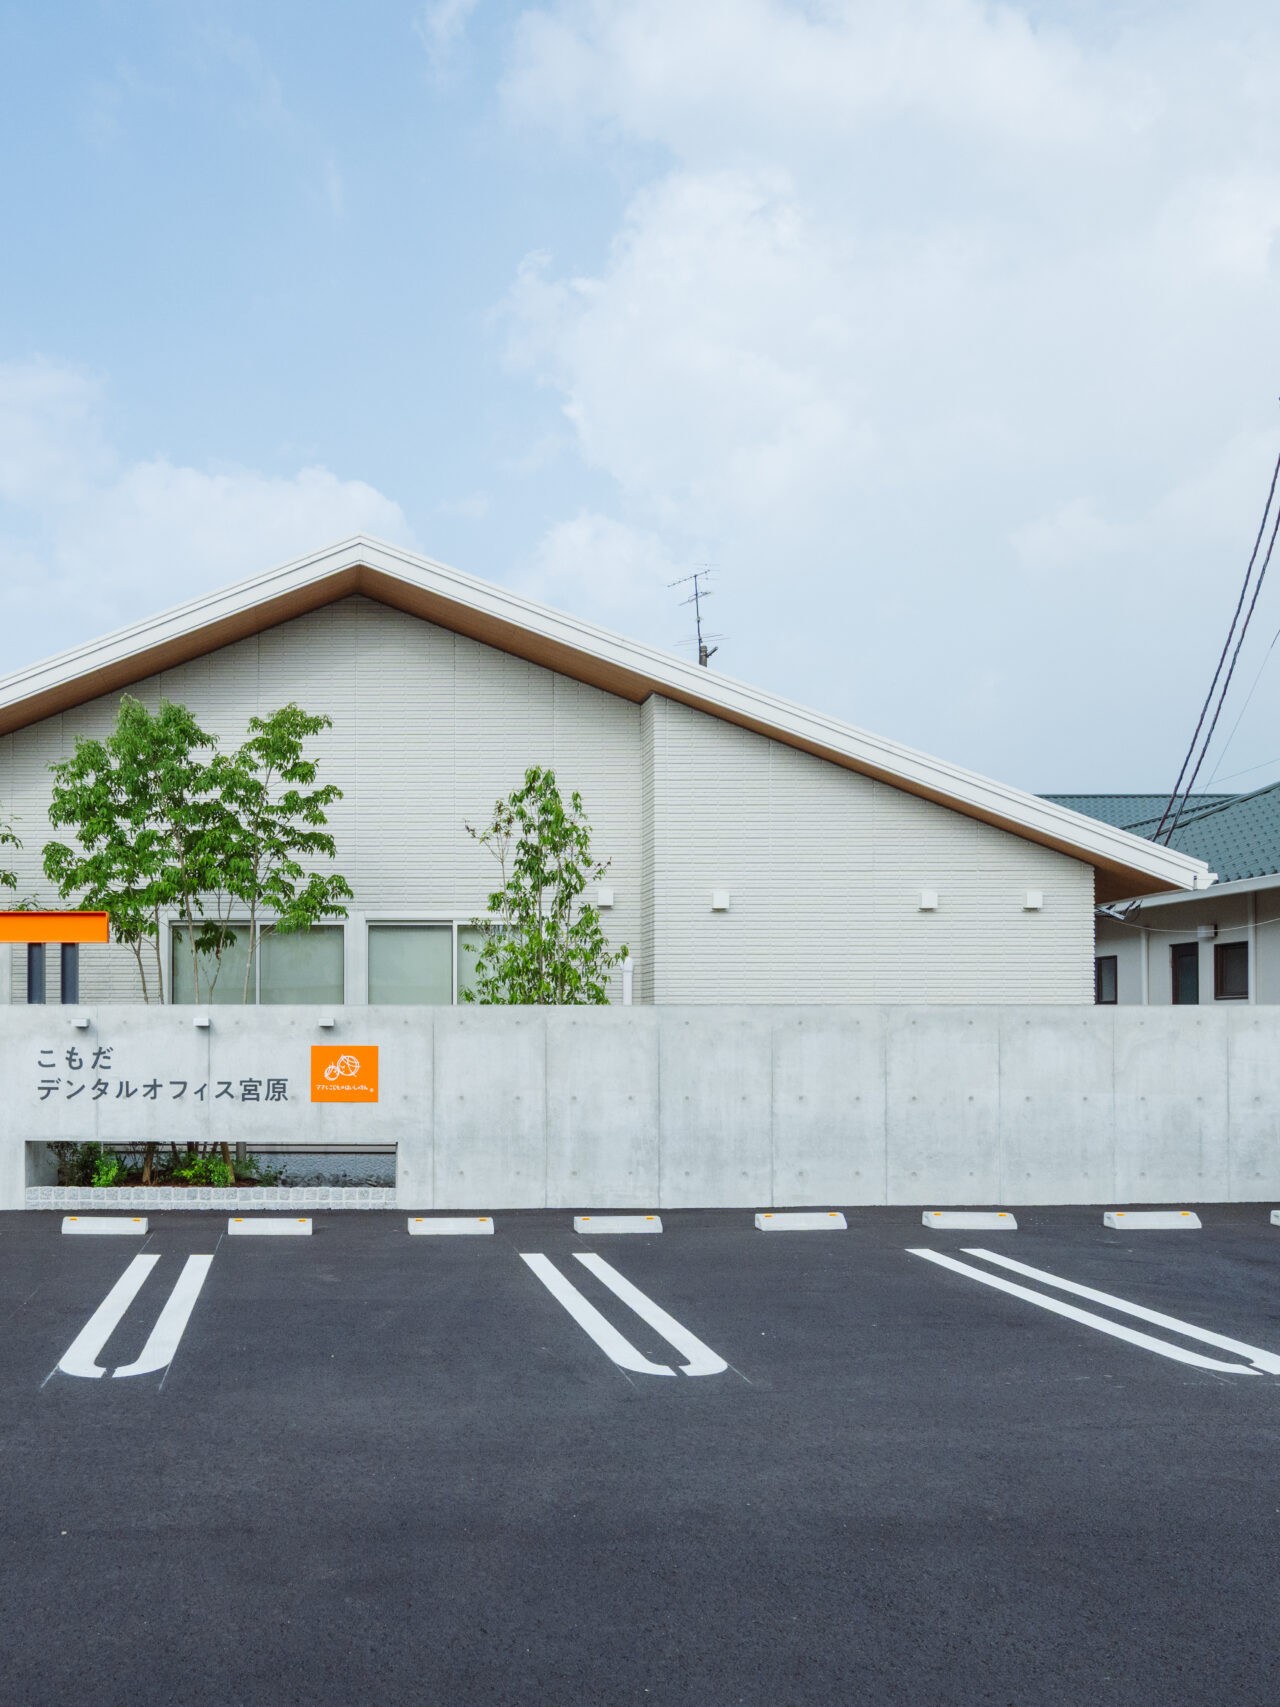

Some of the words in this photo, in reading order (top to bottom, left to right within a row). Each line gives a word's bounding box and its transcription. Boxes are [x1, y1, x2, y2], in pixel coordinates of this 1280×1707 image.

[37, 1046, 114, 1071] こもだ
[37, 1077, 289, 1102] デンタルオフィス宮原
